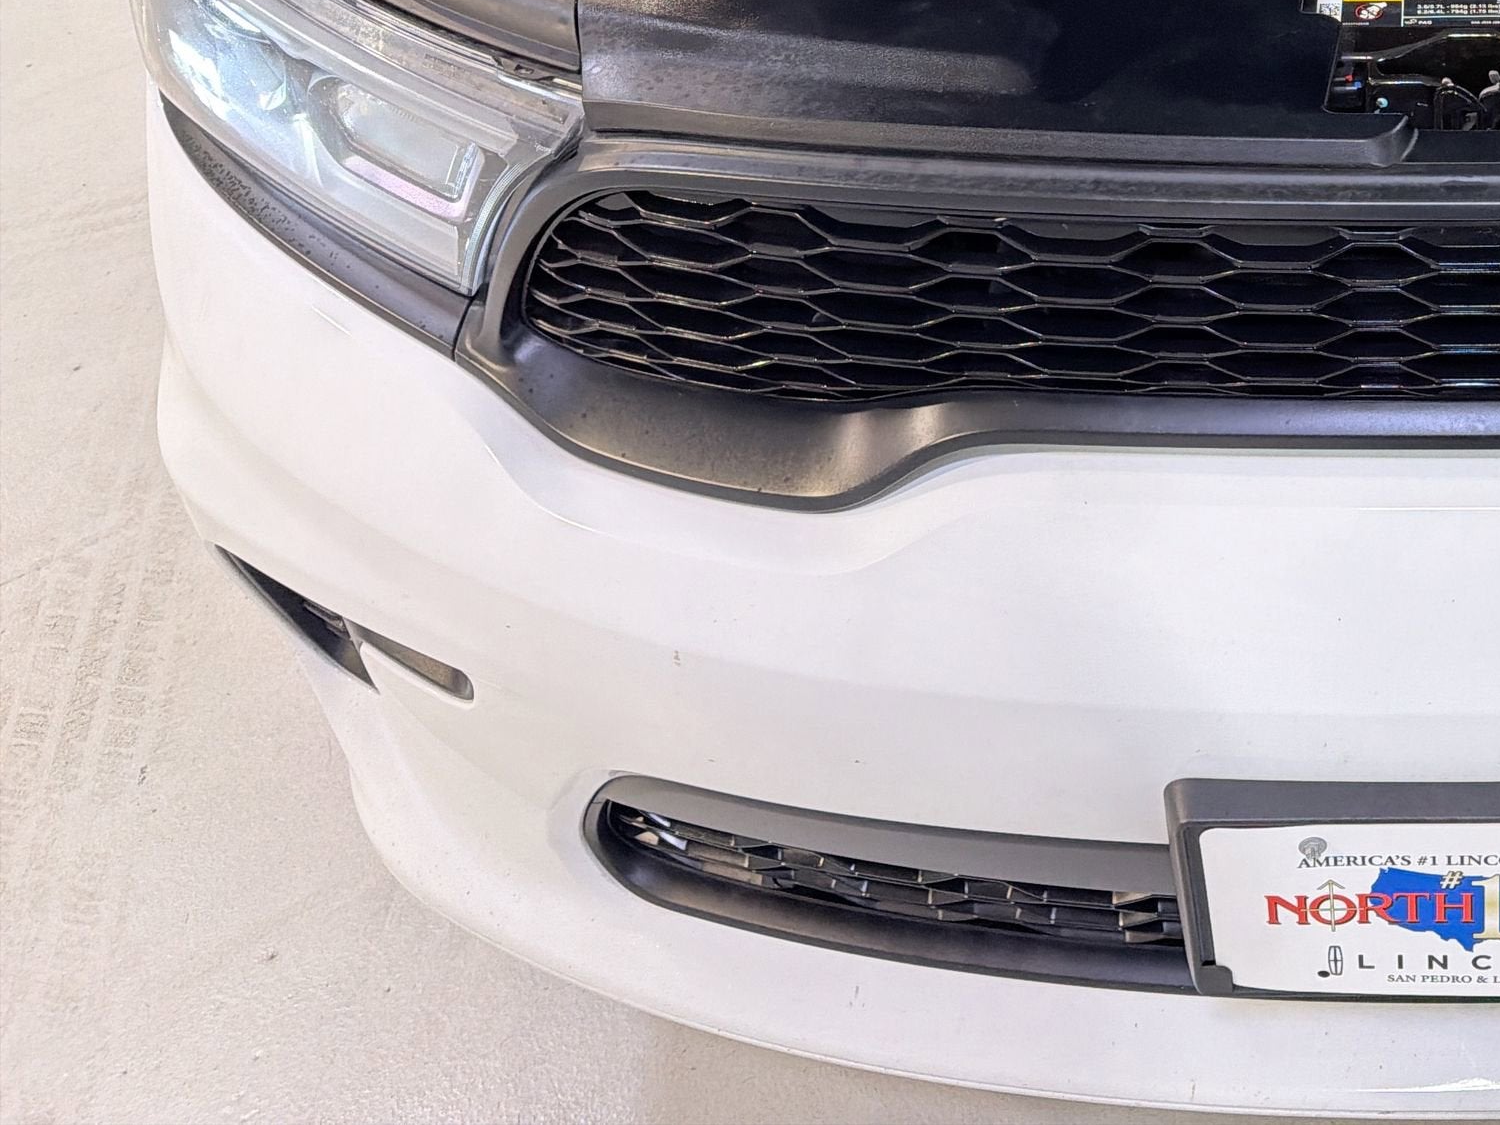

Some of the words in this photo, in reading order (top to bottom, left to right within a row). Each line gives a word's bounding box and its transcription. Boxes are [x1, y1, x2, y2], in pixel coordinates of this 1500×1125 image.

[1297, 854, 1412, 869] AMERICA'S
[1416, 855, 1439, 866] #1
[1264, 891, 1475, 926] NORTH
[1387, 974, 1417, 983] SAN
[1421, 974, 1473, 984] PEDRO
[1476, 975, 1489, 984] &
